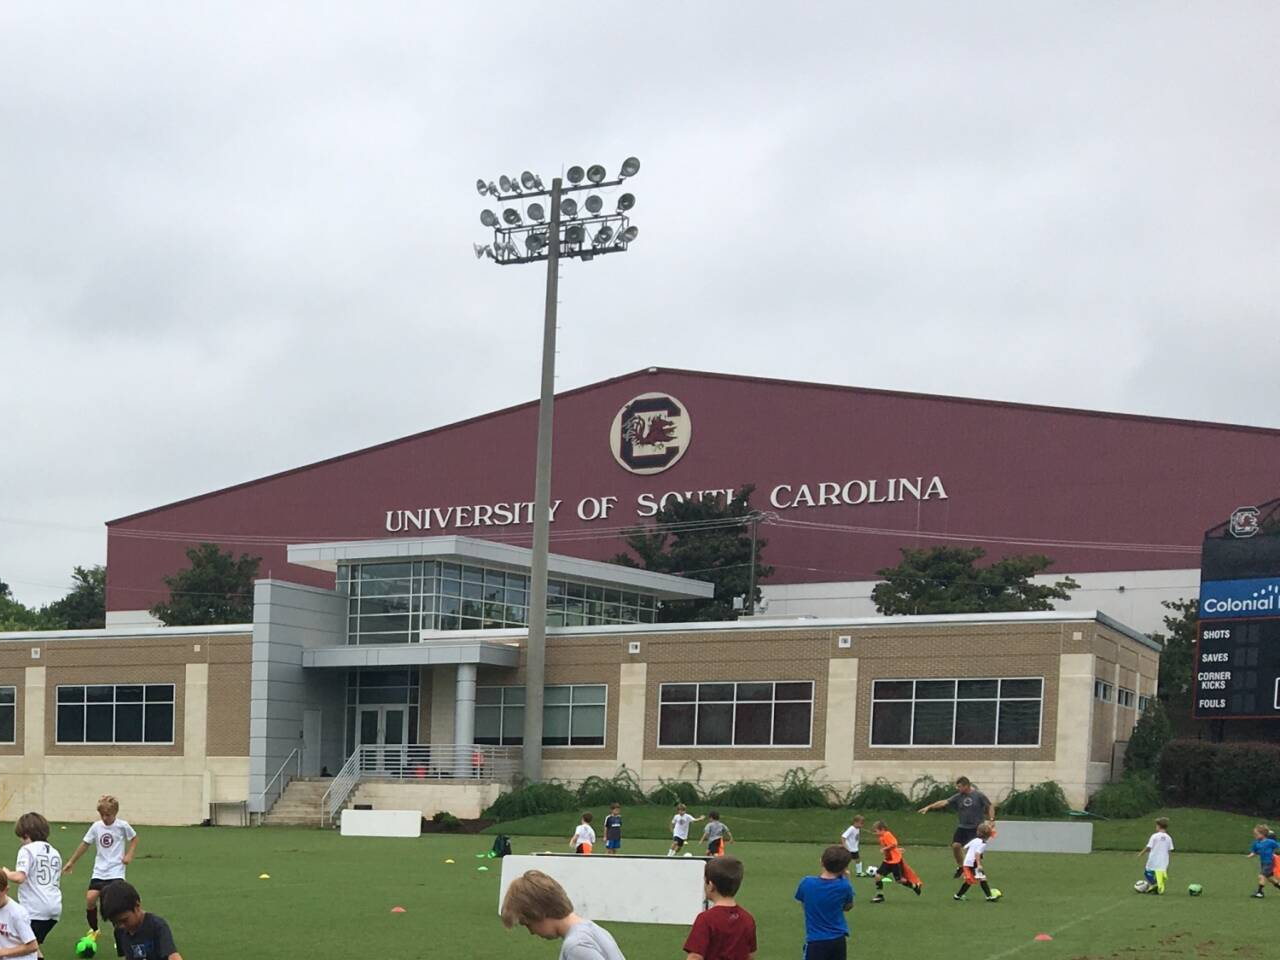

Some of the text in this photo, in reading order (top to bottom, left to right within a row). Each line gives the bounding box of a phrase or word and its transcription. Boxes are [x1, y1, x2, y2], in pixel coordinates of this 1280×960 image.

[386, 499, 562, 532] UNIVERSITY
[577, 496, 618, 520] OF
[770, 476, 949, 508] CAROLINA
[1204, 594, 1274, 613] Colonial
[1203, 629, 1231, 640] SHOTS
[1201, 653, 1229, 663] SAVES
[1197, 671, 1231, 681] CORNER
[1201, 680, 1226, 690] KICKS
[1199, 699, 1226, 708] FOULS
